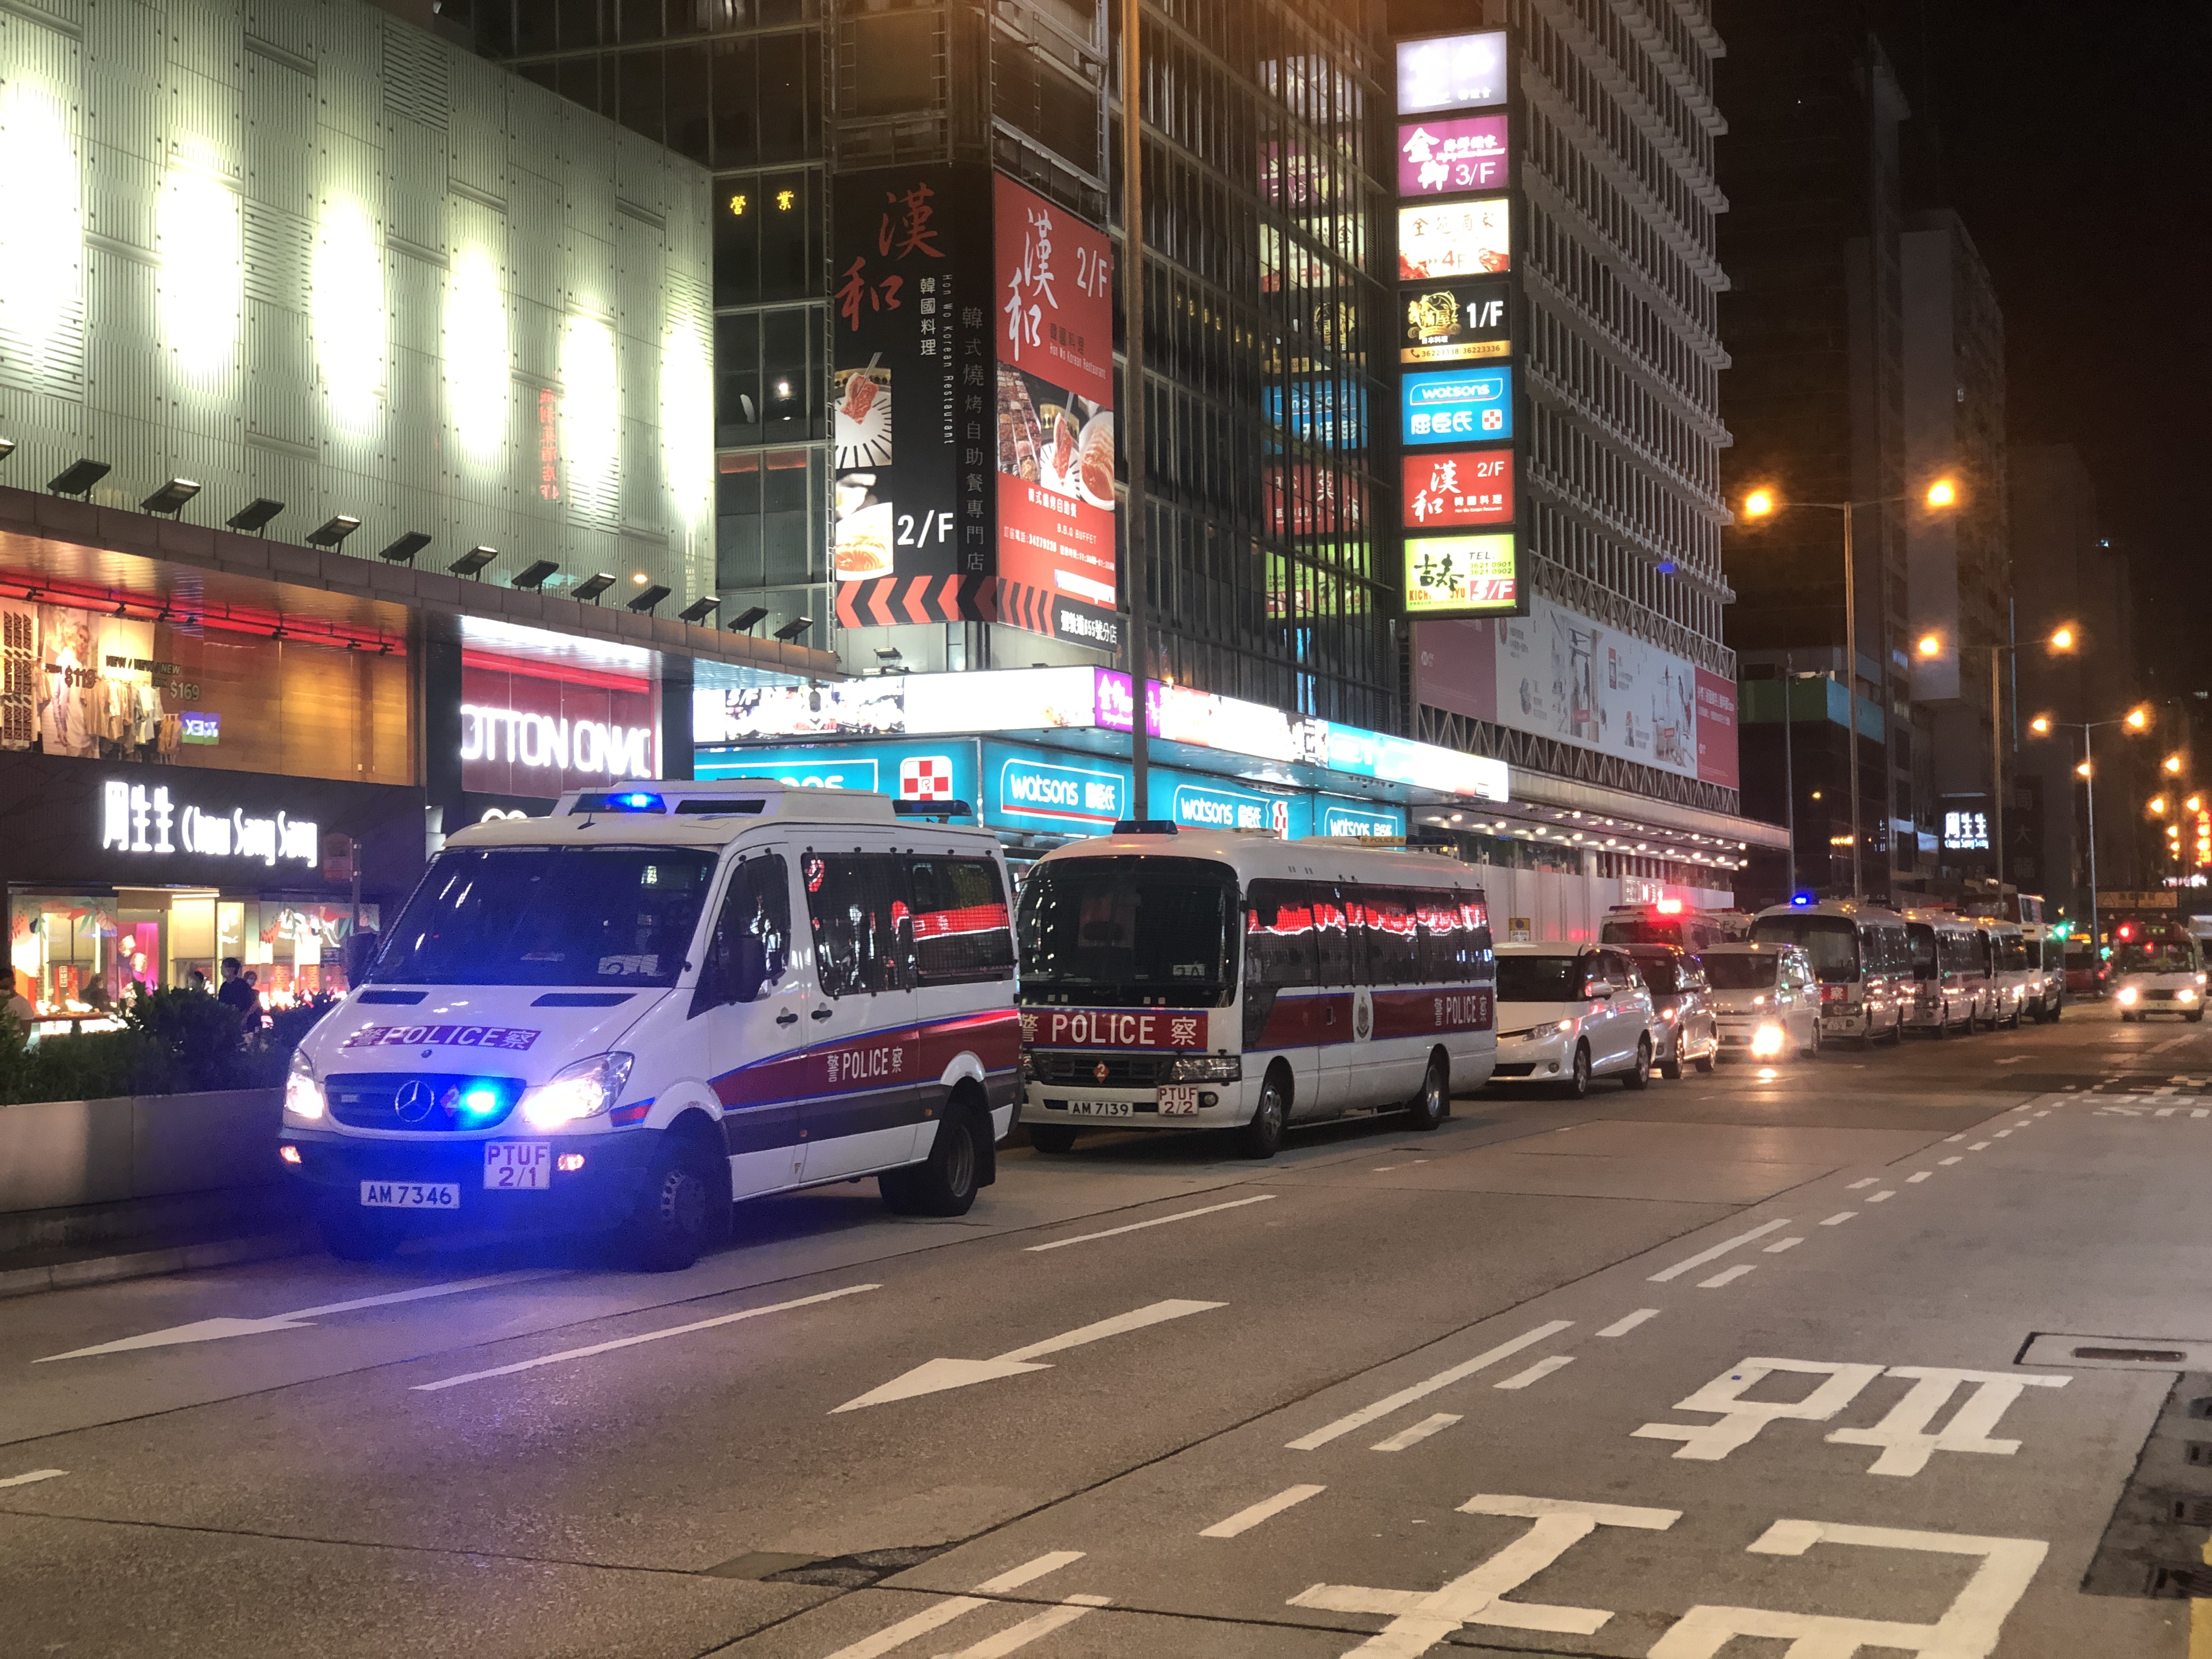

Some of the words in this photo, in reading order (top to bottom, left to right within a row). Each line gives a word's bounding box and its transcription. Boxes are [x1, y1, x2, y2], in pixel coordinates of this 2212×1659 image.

[1455, 162, 1496, 185] 3/F
[1442, 250, 1466, 269] 4F
[1077, 246, 1107, 297] 2/F
[943, 275, 953, 295] Hon
[920, 278, 936, 356] 韓國料理
[943, 303, 953, 317] Wo
[1466, 301, 1503, 328] 1/F
[943, 326, 953, 367] Korean
[1463, 345, 1500, 354] 36223336
[1422, 384, 1489, 399] watsons
[944, 375, 955, 444] Restaurant
[1411, 411, 1472, 435] 屈臣氏
[962, 306, 985, 571] 韓式燒烤自助餐專門店
[1477, 461, 1504, 477] 2/F
[1410, 460, 1462, 522] 漢和
[897, 510, 953, 548] 2/F
[1075, 529, 1097, 544] BUFFET
[1472, 580, 1513, 600] 5/F
[65, 665, 95, 689] $119
[170, 680, 200, 702] $169
[727, 689, 760, 706] 5/F
[1011, 774, 1079, 806] watsons
[104, 782, 175, 852] 周生生
[1181, 798, 1233, 825] watsons
[1944, 813, 1987, 838] 周生生
[1446, 995, 1476, 1024] POLICE
[380, 1026, 499, 1046] POLICE
[502, 1029, 535, 1050] 察
[1052, 1014, 1156, 1045] POLICE
[1171, 1016, 1197, 1045] 察
[827, 1054, 838, 1082] 警
[842, 1048, 888, 1080] POLICE
[891, 1047, 903, 1074] 察
[1098, 1064, 1105, 1077] 2
[1160, 1087, 1197, 1101] PTUF
[1073, 1102, 1091, 1115] AM
[1096, 1103, 1128, 1116] 7139
[1164, 1101, 1193, 1114] 2/2
[488, 1146, 547, 1165] PTUF
[498, 1167, 537, 1186] 2/1
[367, 1187, 392, 1203] AM
[398, 1186, 452, 1205] 7346
